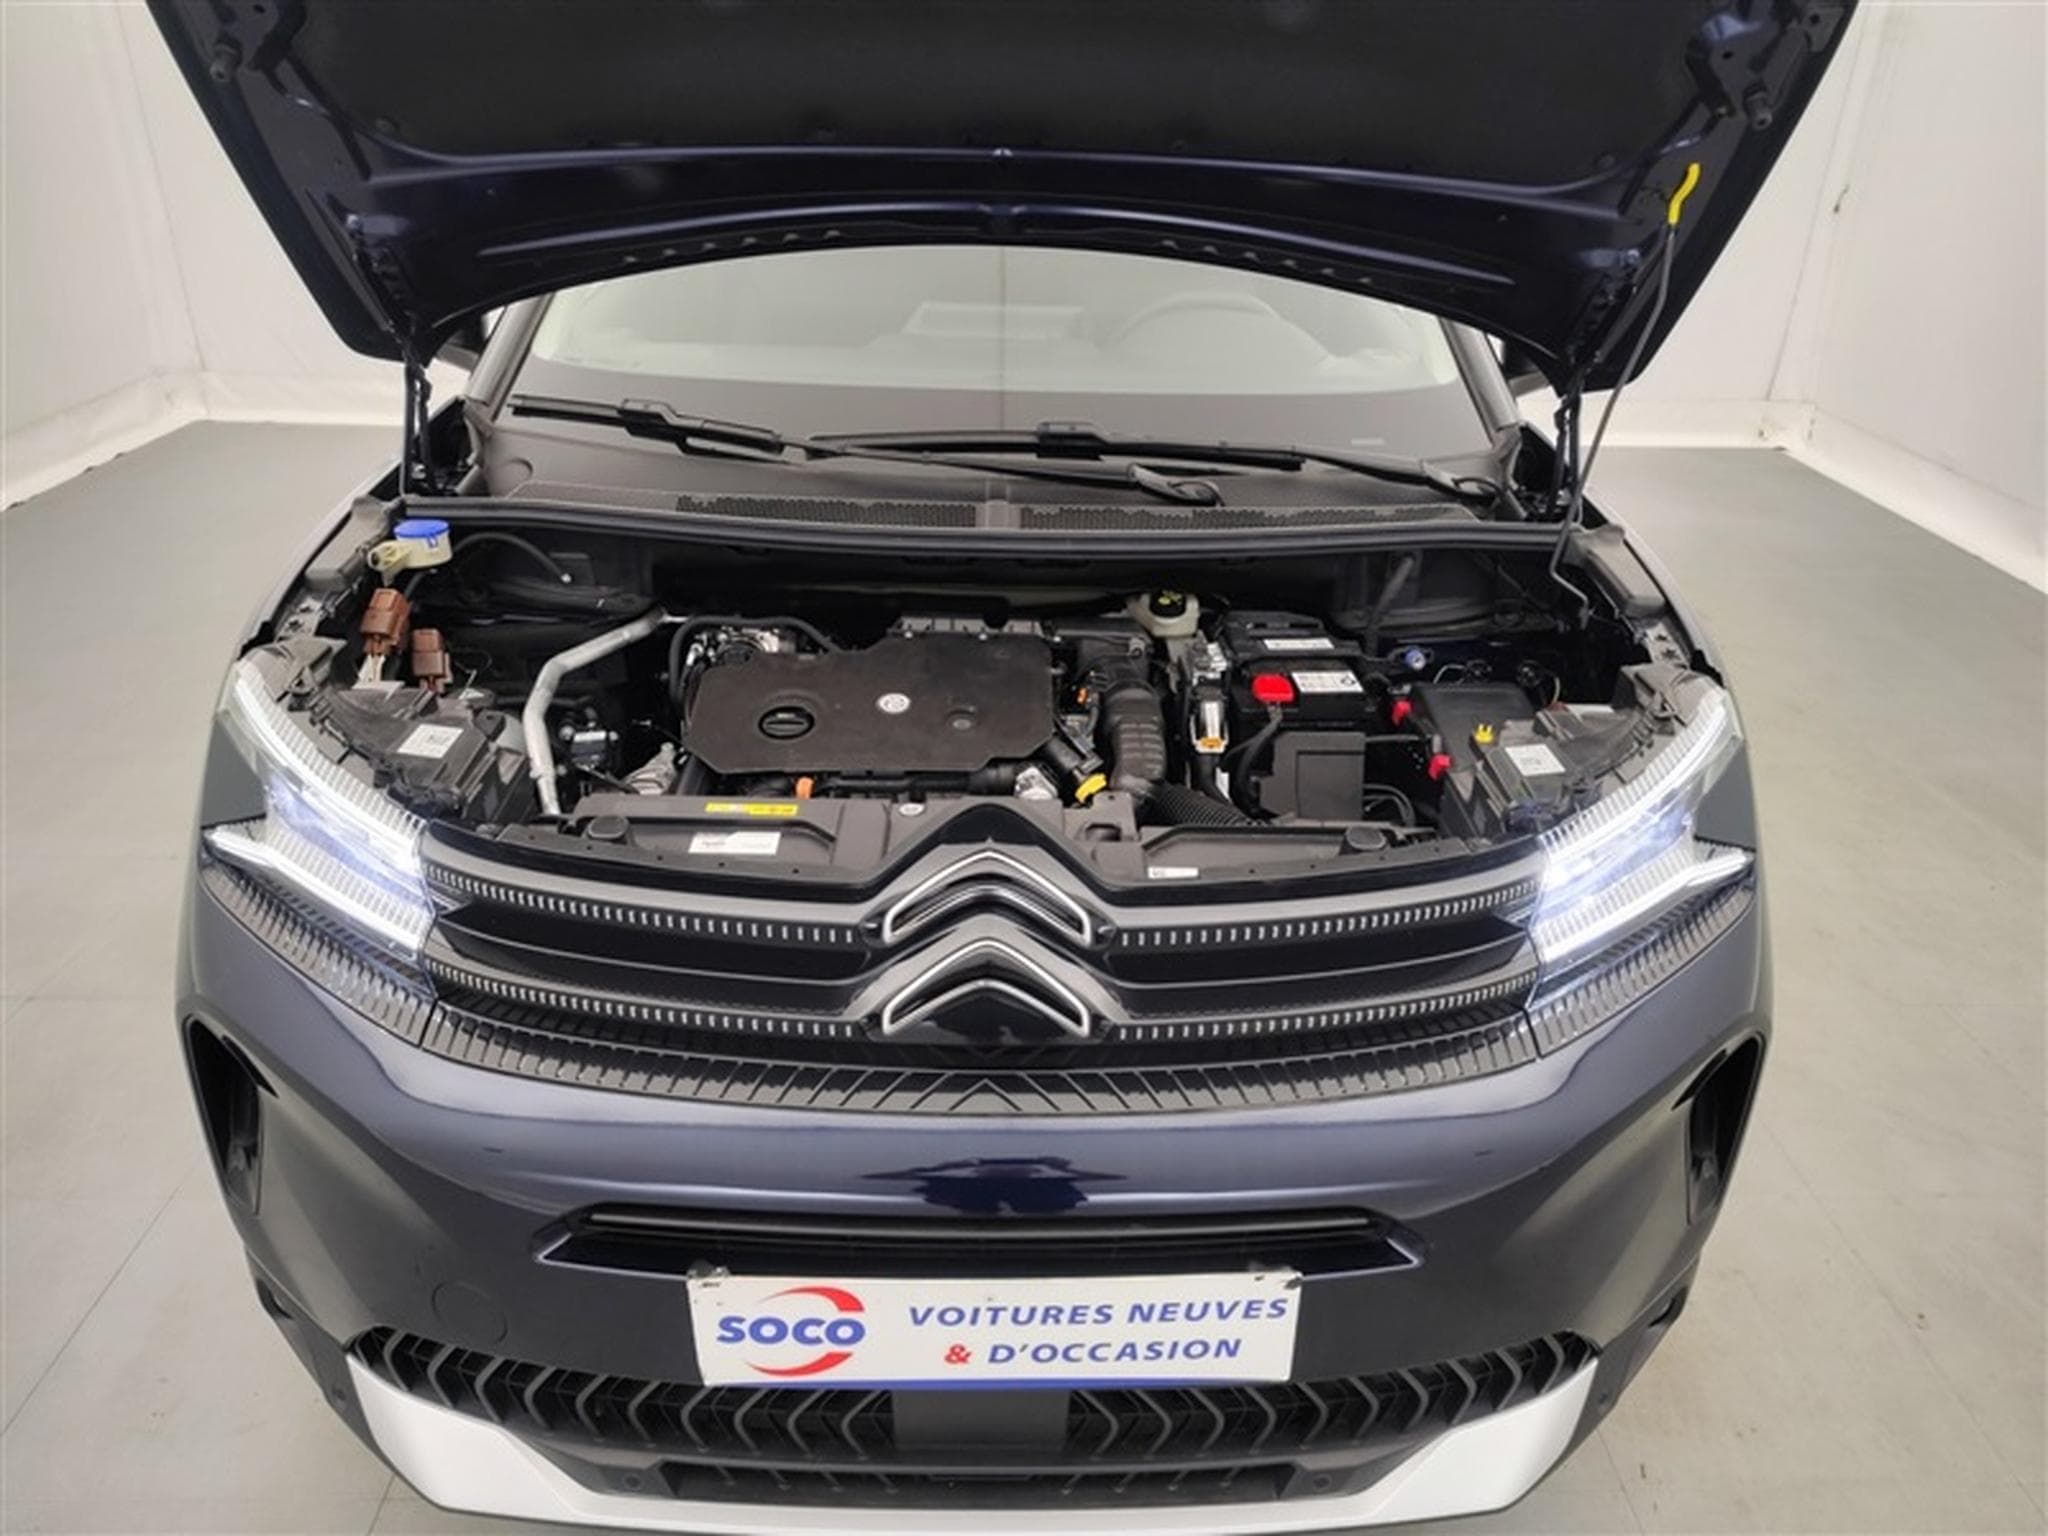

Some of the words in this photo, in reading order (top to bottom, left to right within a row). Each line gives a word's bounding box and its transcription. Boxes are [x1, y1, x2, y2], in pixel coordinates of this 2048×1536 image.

[909, 1305, 1113, 1326] VOITURES
[1128, 1299, 1288, 1324] NEUVES
[717, 1315, 866, 1345] SOCO
[944, 1344, 972, 1365] &
[988, 1339, 1242, 1363] D'OCCASION
